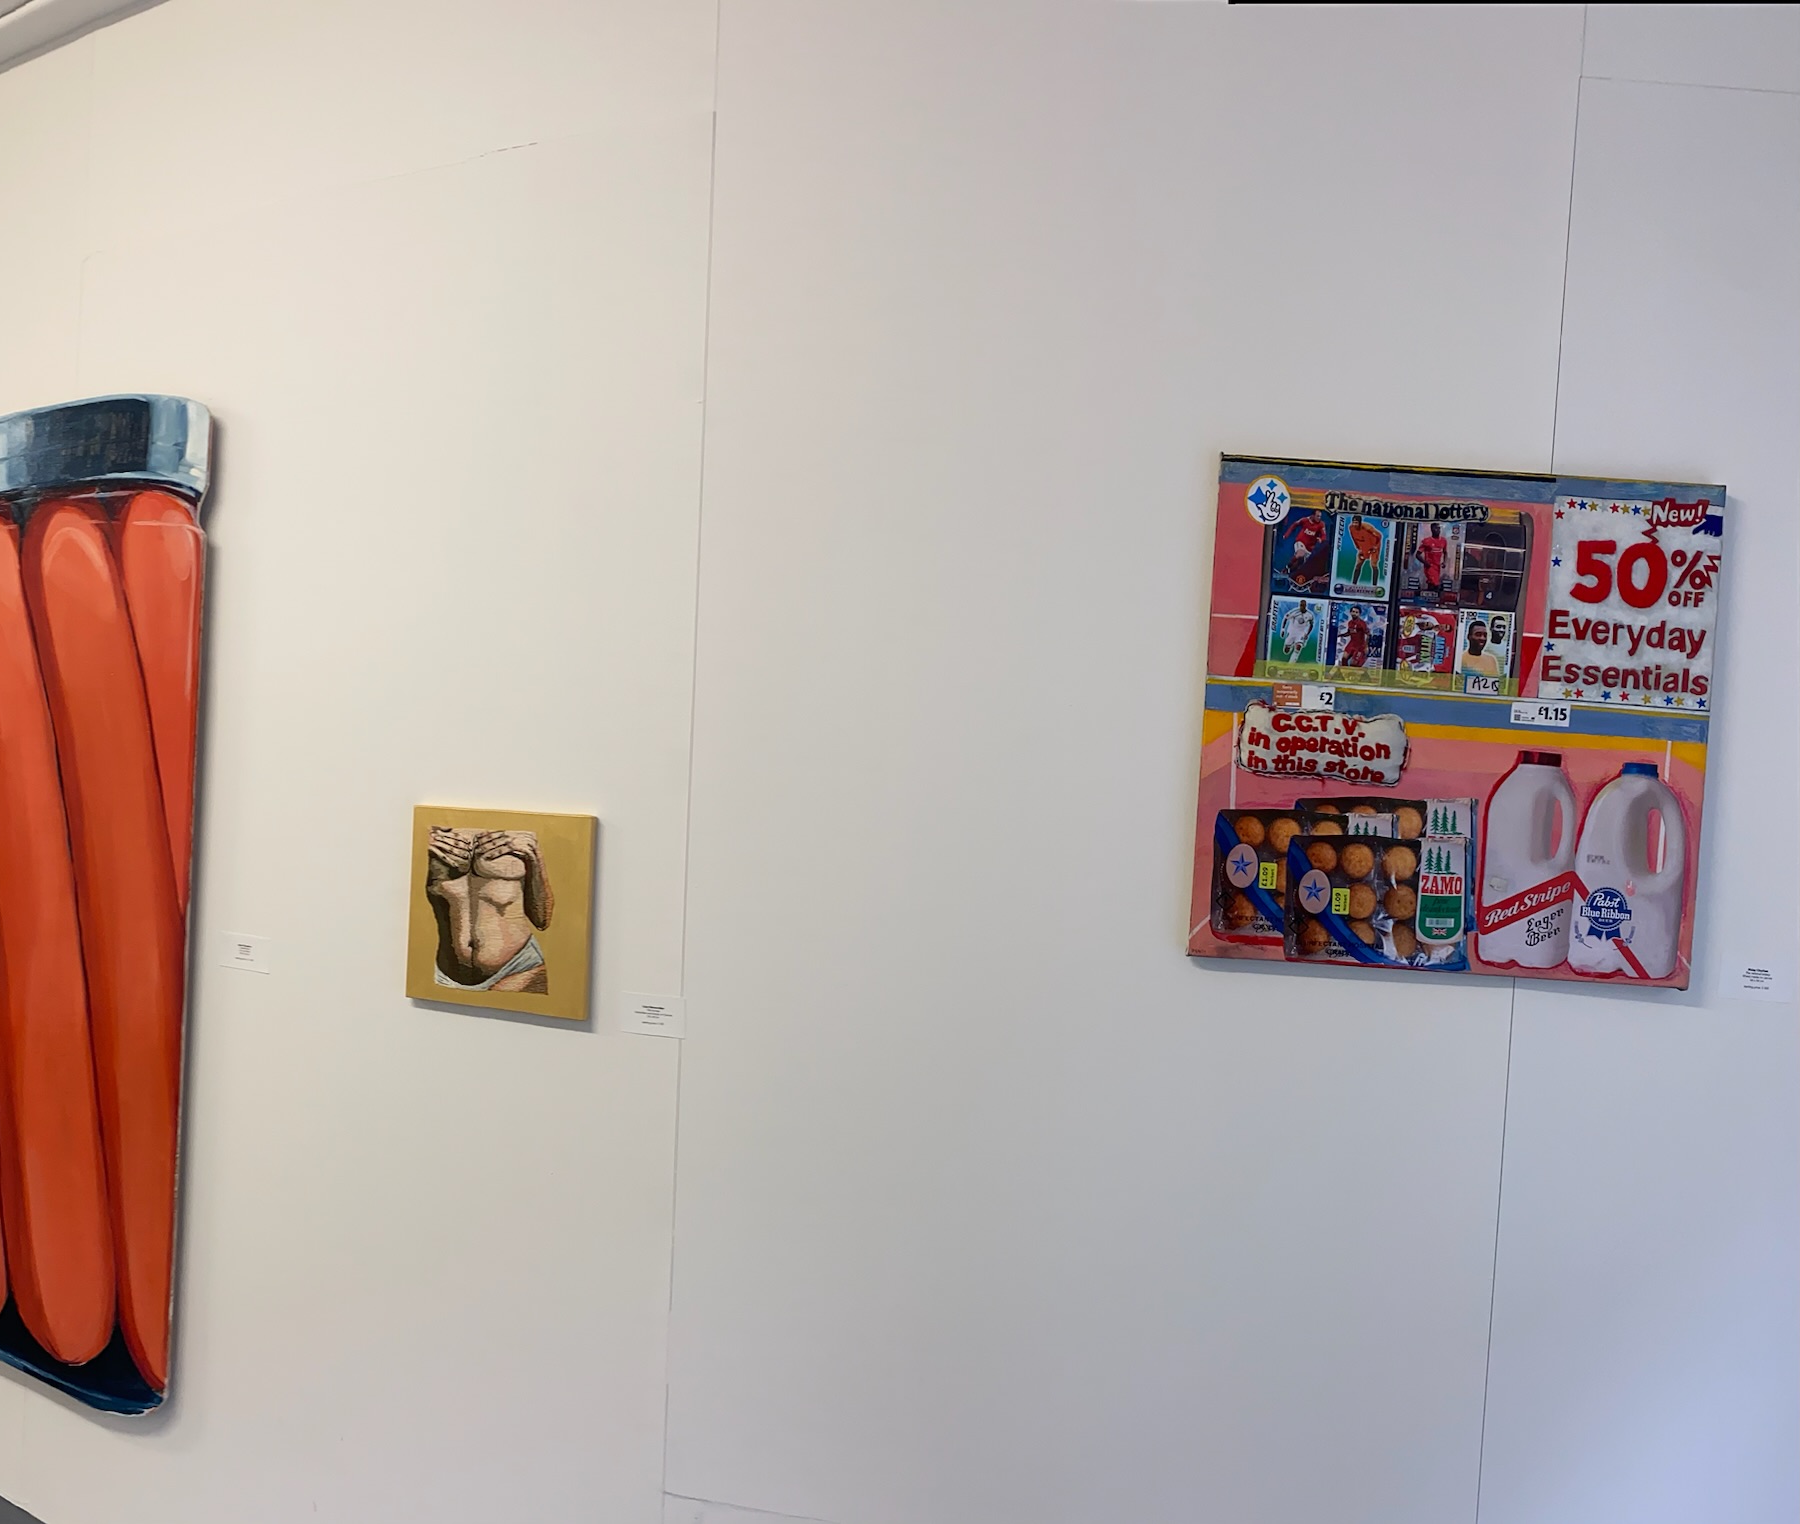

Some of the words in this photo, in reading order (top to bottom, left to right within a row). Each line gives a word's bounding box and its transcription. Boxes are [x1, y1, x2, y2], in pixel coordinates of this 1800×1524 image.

[1326, 492, 1358, 511] The
[1361, 499, 1429, 519] national
[1434, 503, 1489, 522] lottery
[1652, 501, 1704, 523] New!
[1569, 539, 1706, 609] 50%
[1667, 591, 1705, 608] OFF
[1420, 634, 1433, 663] ATTAX
[1548, 609, 1707, 660] Everyday
[1433, 635, 1446, 665] MATCH
[1540, 655, 1709, 696] Essentials
[1319, 691, 1334, 706] £2
[1537, 705, 1568, 722] £1.15
[1247, 727, 1271, 750] in
[1275, 735, 1391, 762] operation
[1247, 750, 1268, 771] in
[1271, 754, 1319, 773] this
[1323, 758, 1385, 783] store
[1421, 874, 1463, 895] ZAMO
[1483, 901, 1520, 928] Red
[1520, 881, 1571, 911] Stripe
[1581, 906, 1601, 918] Blue
[1601, 907, 1630, 920] Ribbon
[1592, 892, 1621, 909] Pabst
